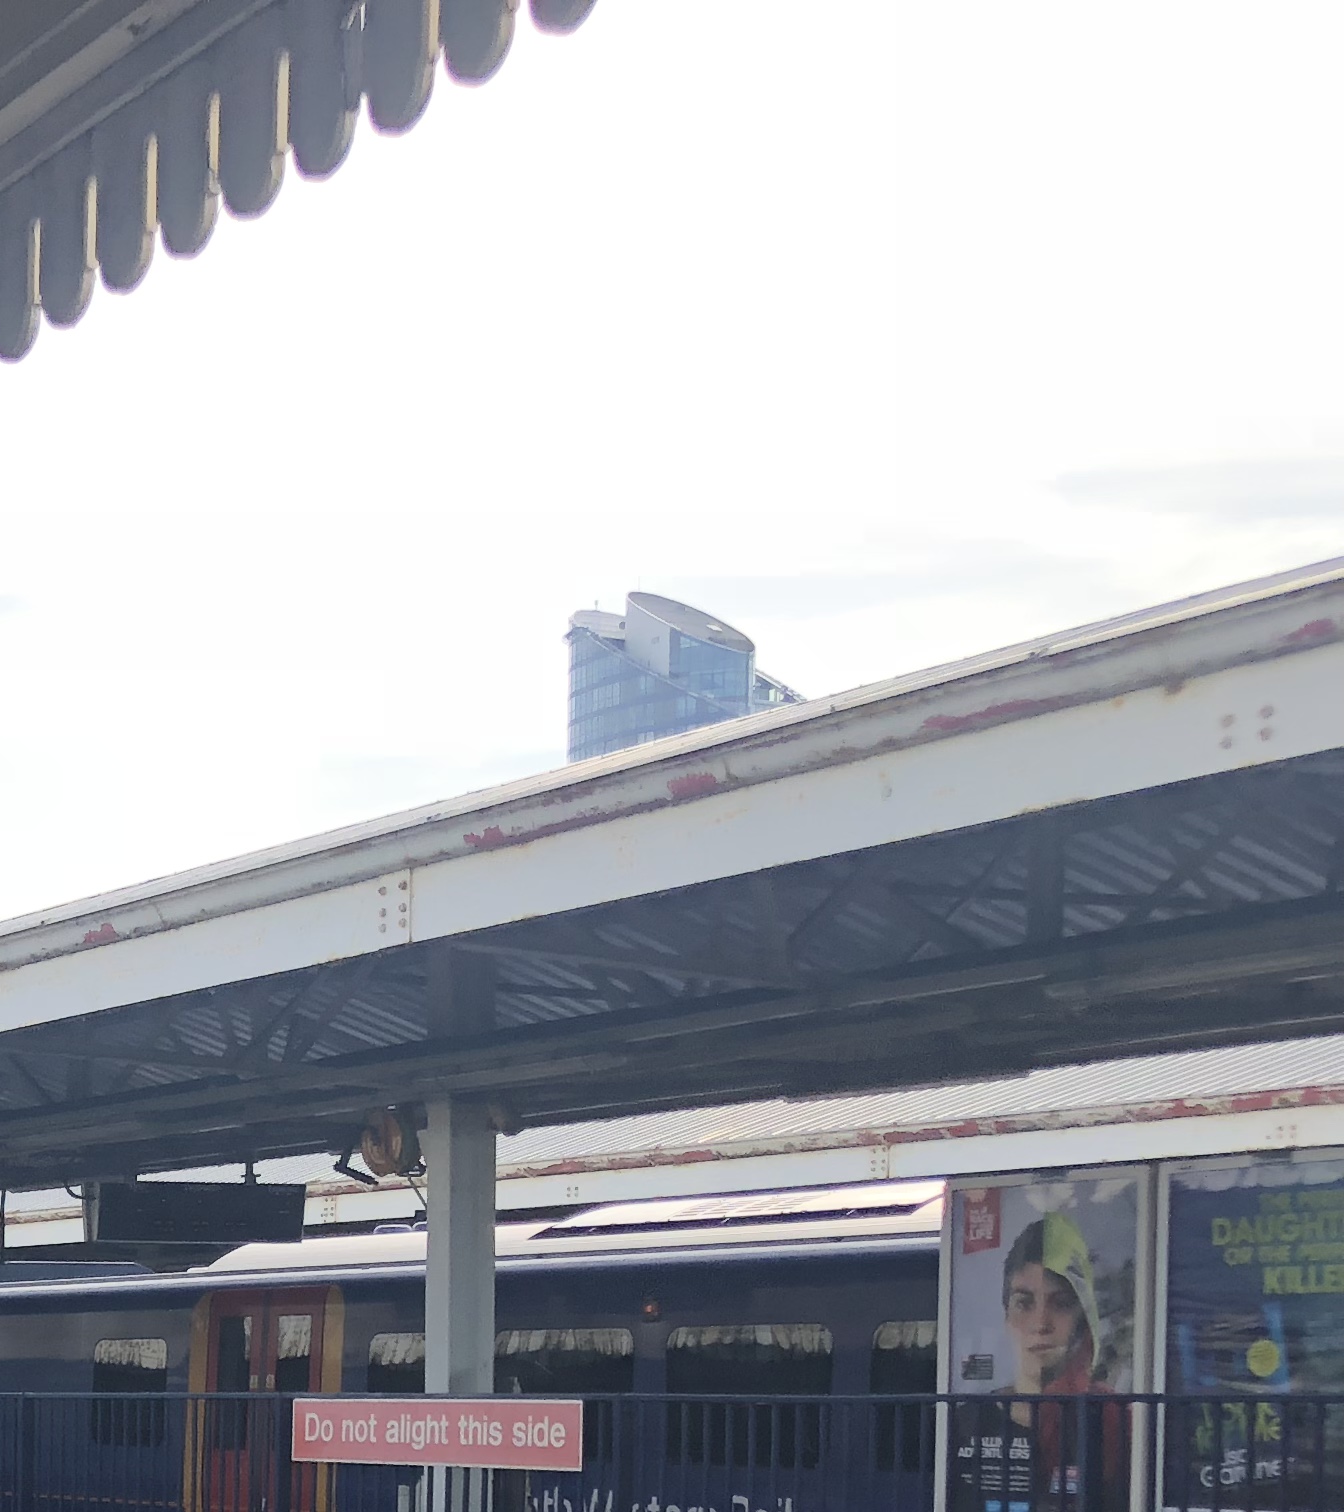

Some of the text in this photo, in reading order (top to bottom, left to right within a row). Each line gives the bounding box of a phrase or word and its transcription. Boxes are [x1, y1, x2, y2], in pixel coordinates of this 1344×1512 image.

[1211, 1211, 1344, 1246] DAUGHT
[304, 1412, 567, 1451] Do not alight this side
[1011, 1436, 1030, 1448] ALL
